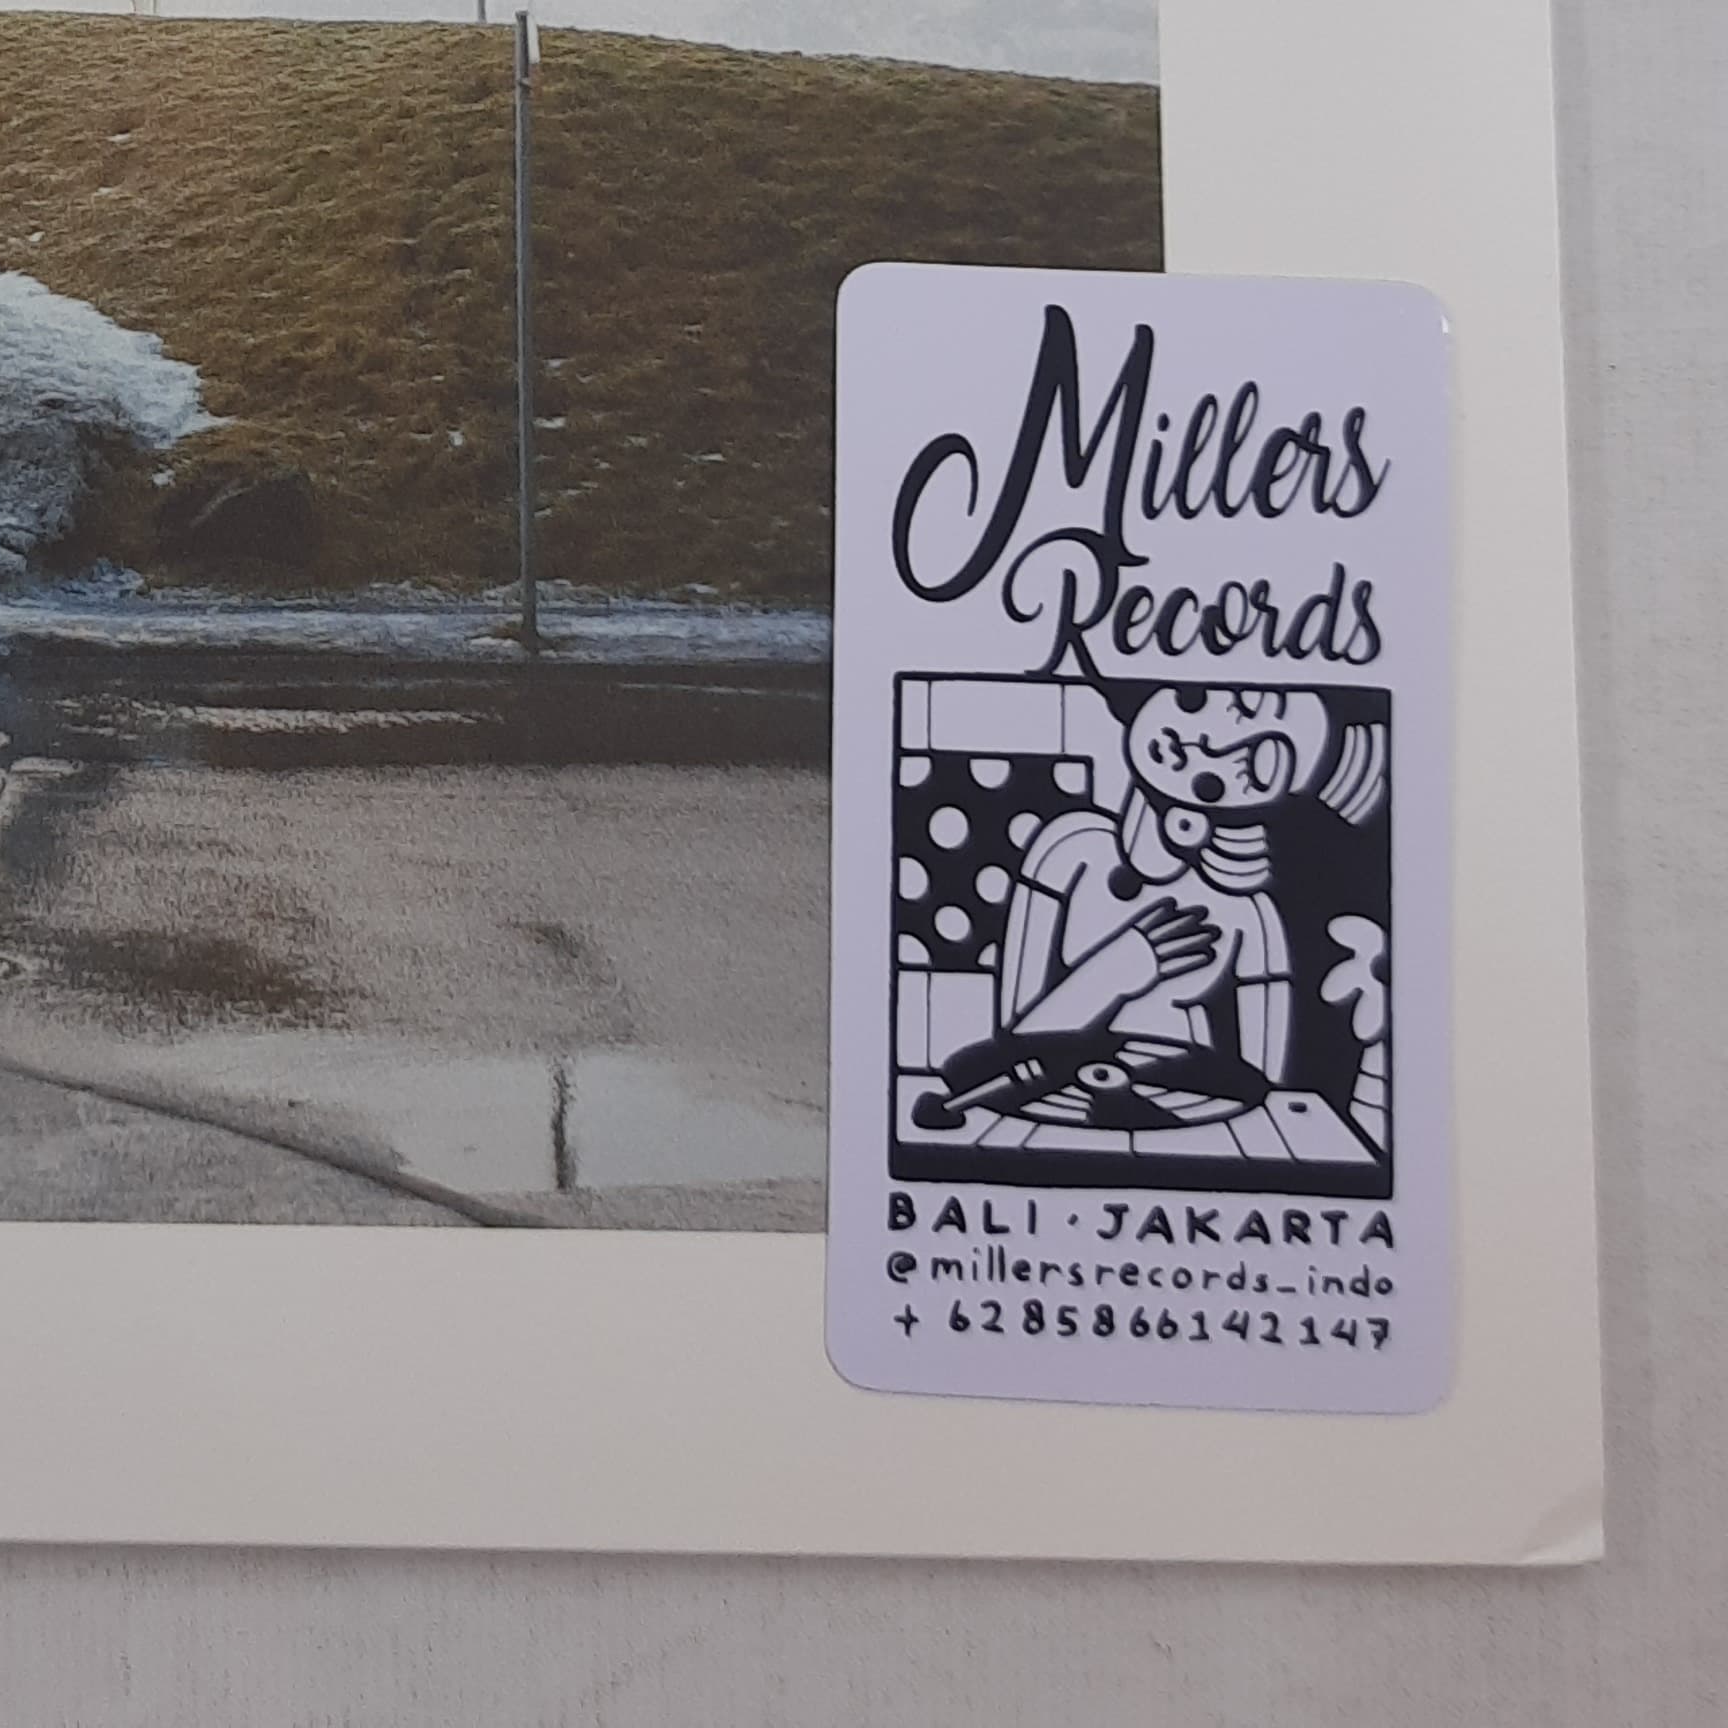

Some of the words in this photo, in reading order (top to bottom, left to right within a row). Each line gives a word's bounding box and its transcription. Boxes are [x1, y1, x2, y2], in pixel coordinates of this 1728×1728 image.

[891, 303, 1392, 604] Millers
[1000, 526, 1382, 688] Records
[885, 1245, 1396, 1300] @millersrecords_indo
